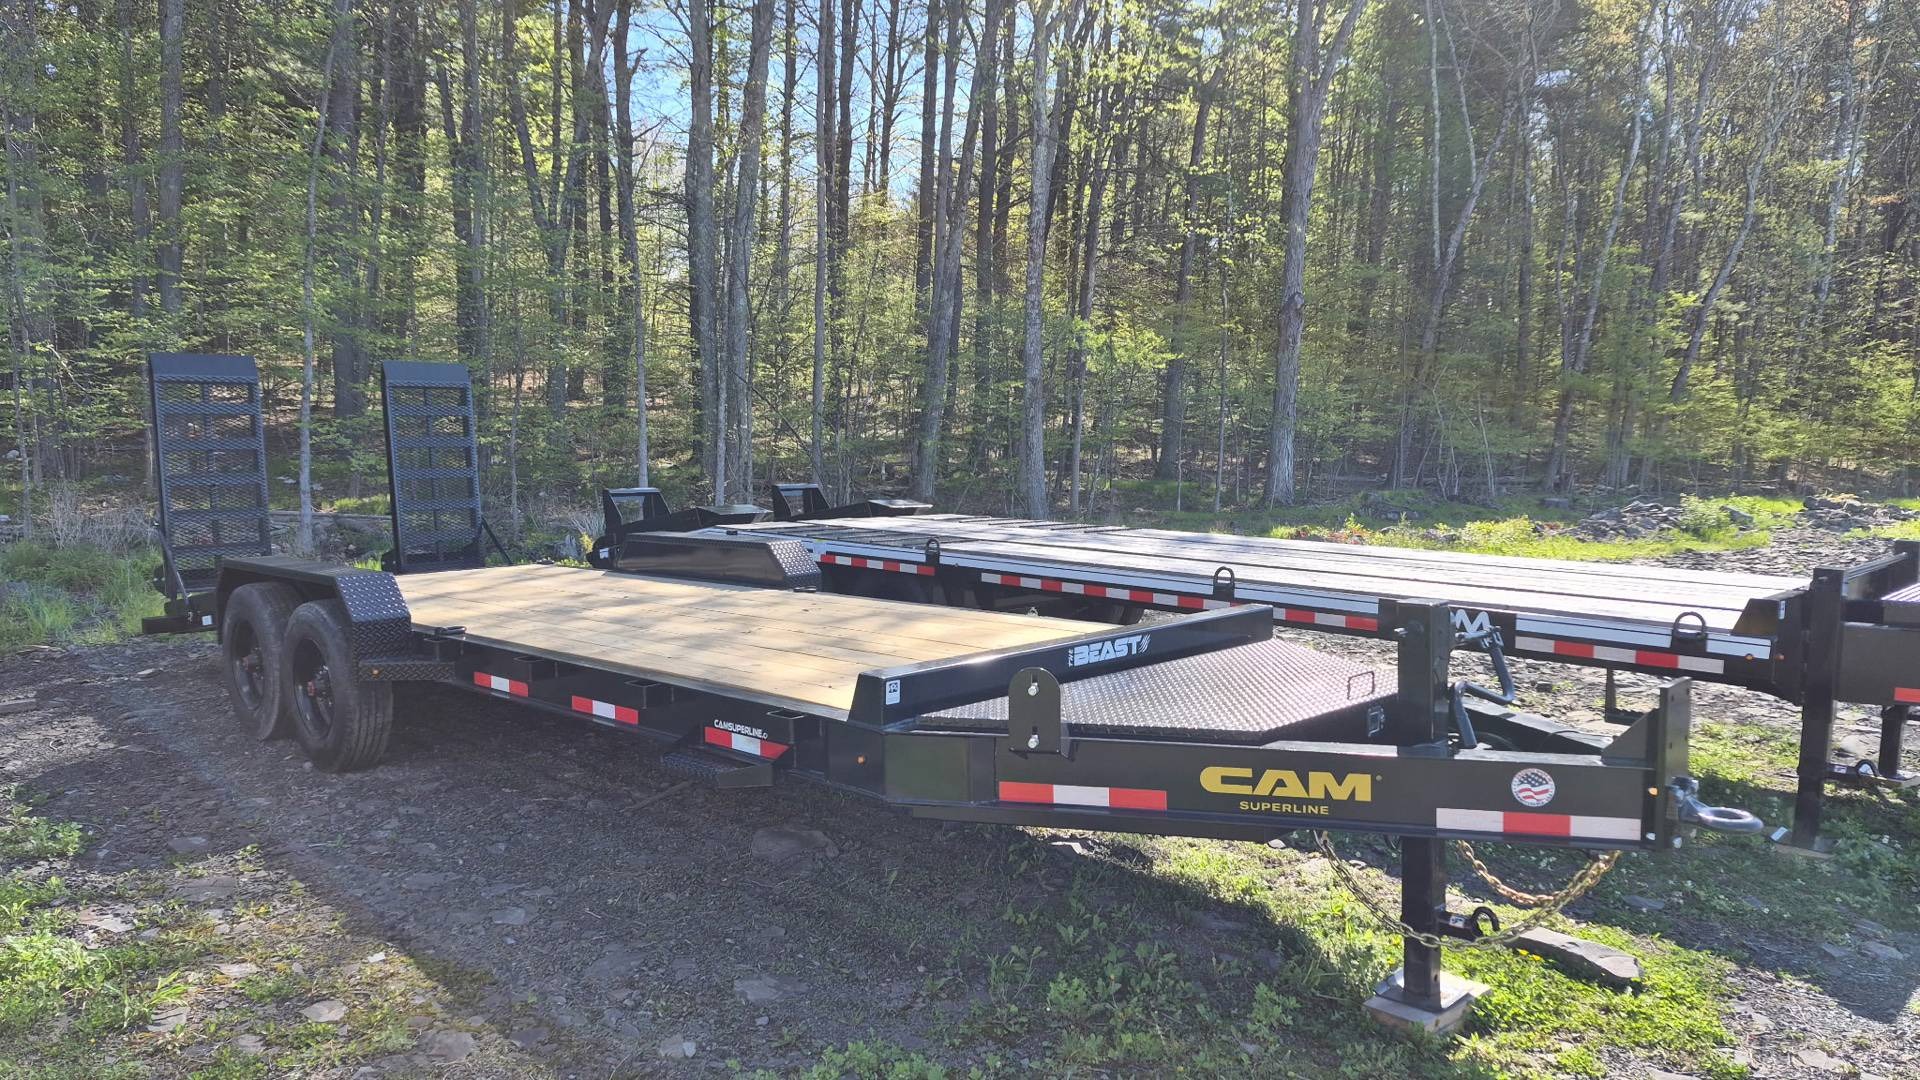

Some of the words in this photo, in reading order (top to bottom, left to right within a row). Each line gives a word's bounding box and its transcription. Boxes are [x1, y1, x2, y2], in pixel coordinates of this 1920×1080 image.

[1073, 634, 1142, 667] BEAST
[1200, 766, 1372, 802] CAM
[1239, 801, 1329, 815] SUPERLINE
